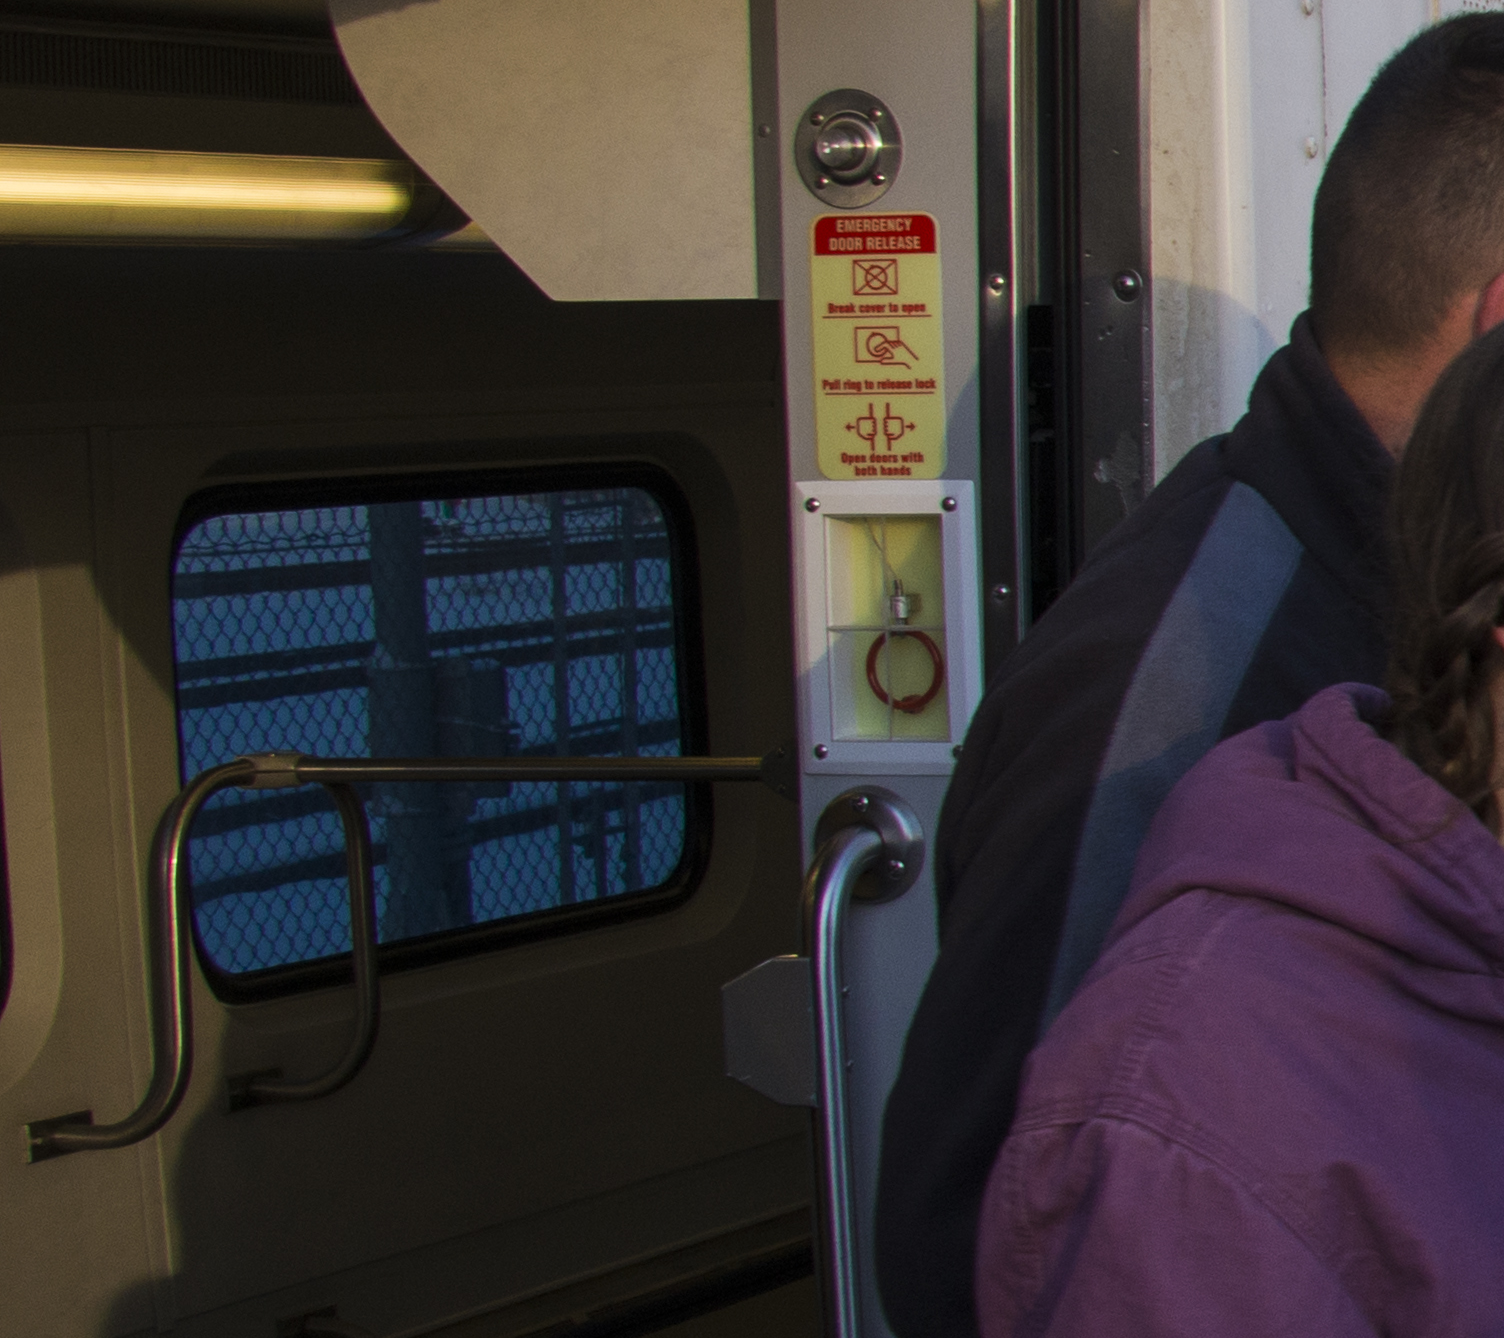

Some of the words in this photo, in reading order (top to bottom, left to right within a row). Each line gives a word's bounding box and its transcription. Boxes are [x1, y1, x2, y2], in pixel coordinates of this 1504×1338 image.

[836, 217, 912, 233] EMERGENCY
[829, 236, 863, 251] DOOR
[866, 235, 921, 250] RELEASE
[828, 302, 856, 314] Break
[860, 303, 887, 314] cover
[889, 302, 900, 314] to
[901, 303, 926, 316] open
[822, 379, 842, 391] Pull
[843, 379, 862, 393] ring
[864, 379, 875, 390] to
[877, 378, 913, 391] release
[915, 378, 937, 390] lock
[841, 452, 867, 466] Open
[869, 452, 899, 464] doors
[901, 451, 924, 464] with
[855, 465, 878, 476] both
[880, 465, 912, 476] hands
